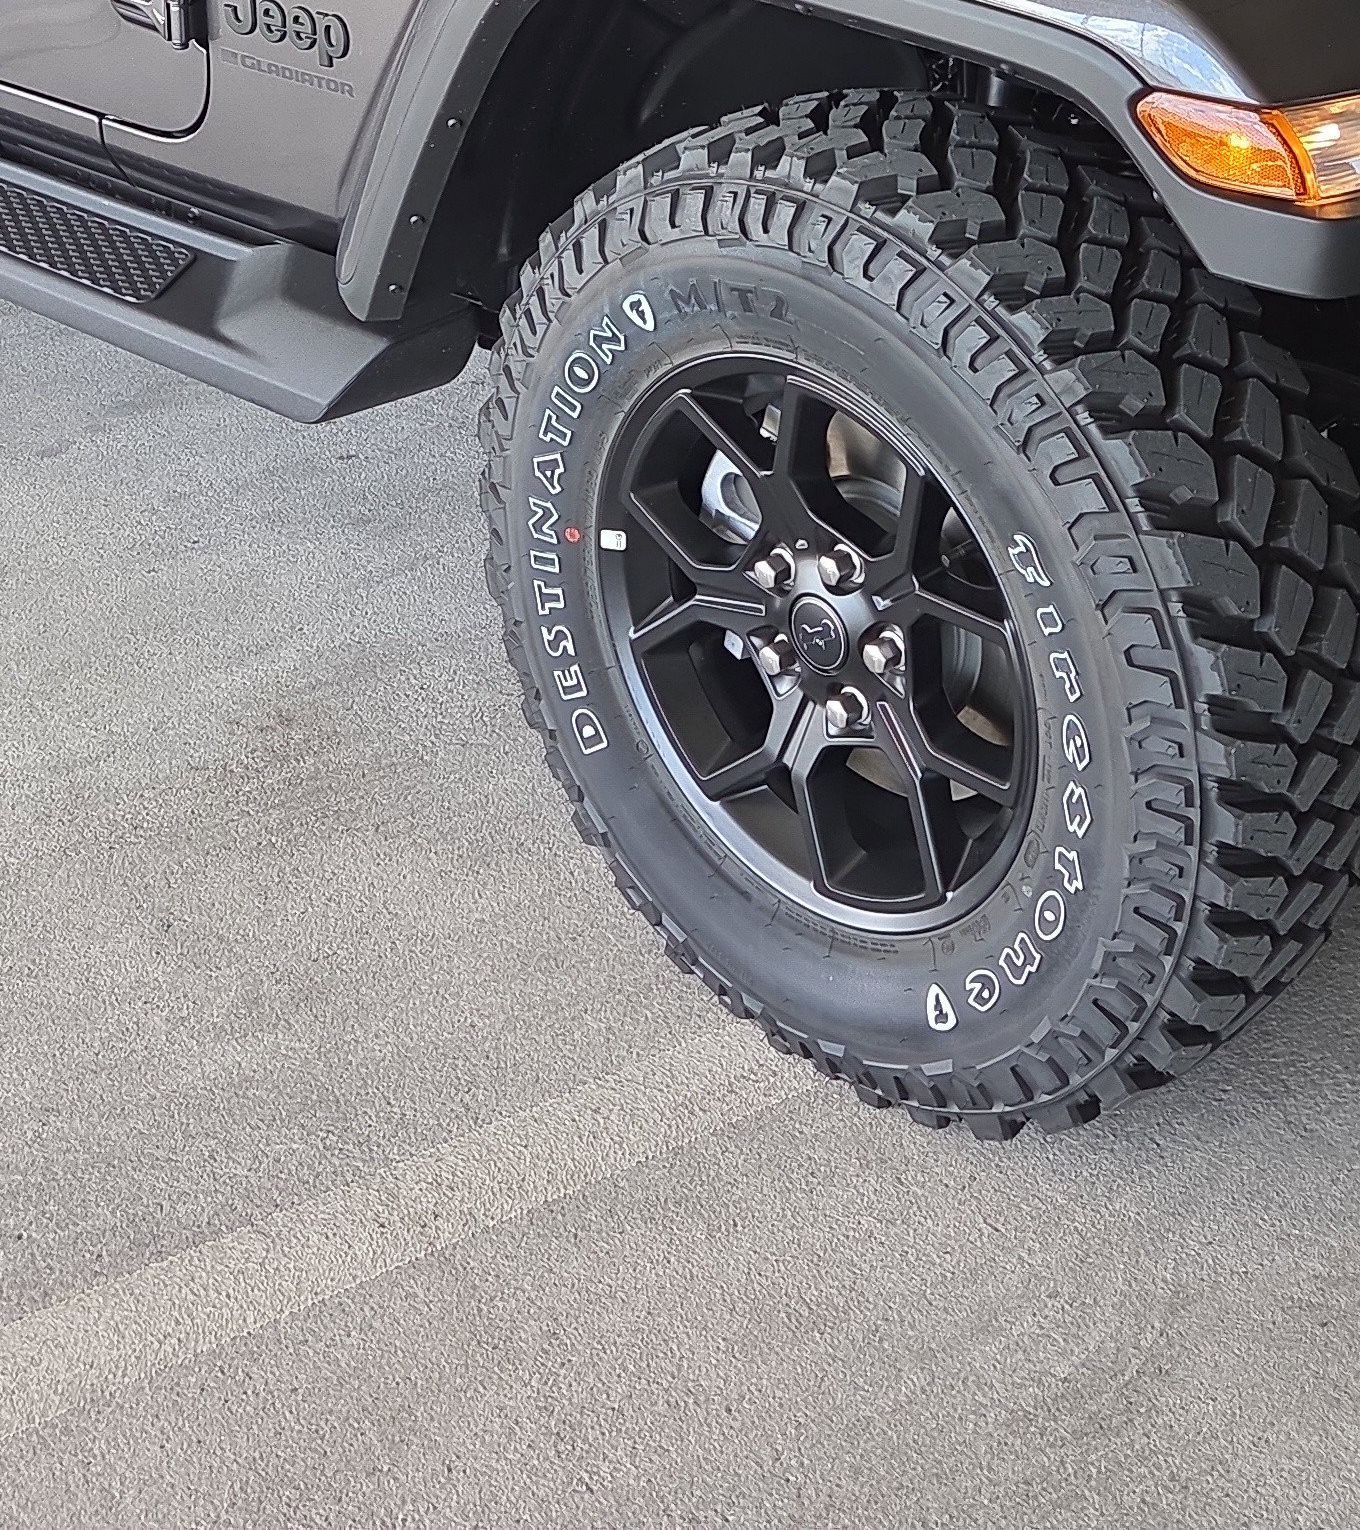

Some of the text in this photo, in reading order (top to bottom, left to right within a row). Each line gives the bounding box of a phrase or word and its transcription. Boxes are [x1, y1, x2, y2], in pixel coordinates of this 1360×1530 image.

[241, 53, 355, 99] GLADIATOR
[527, 316, 626, 755] DESTINATION
[965, 534, 1092, 1012] Firestone
